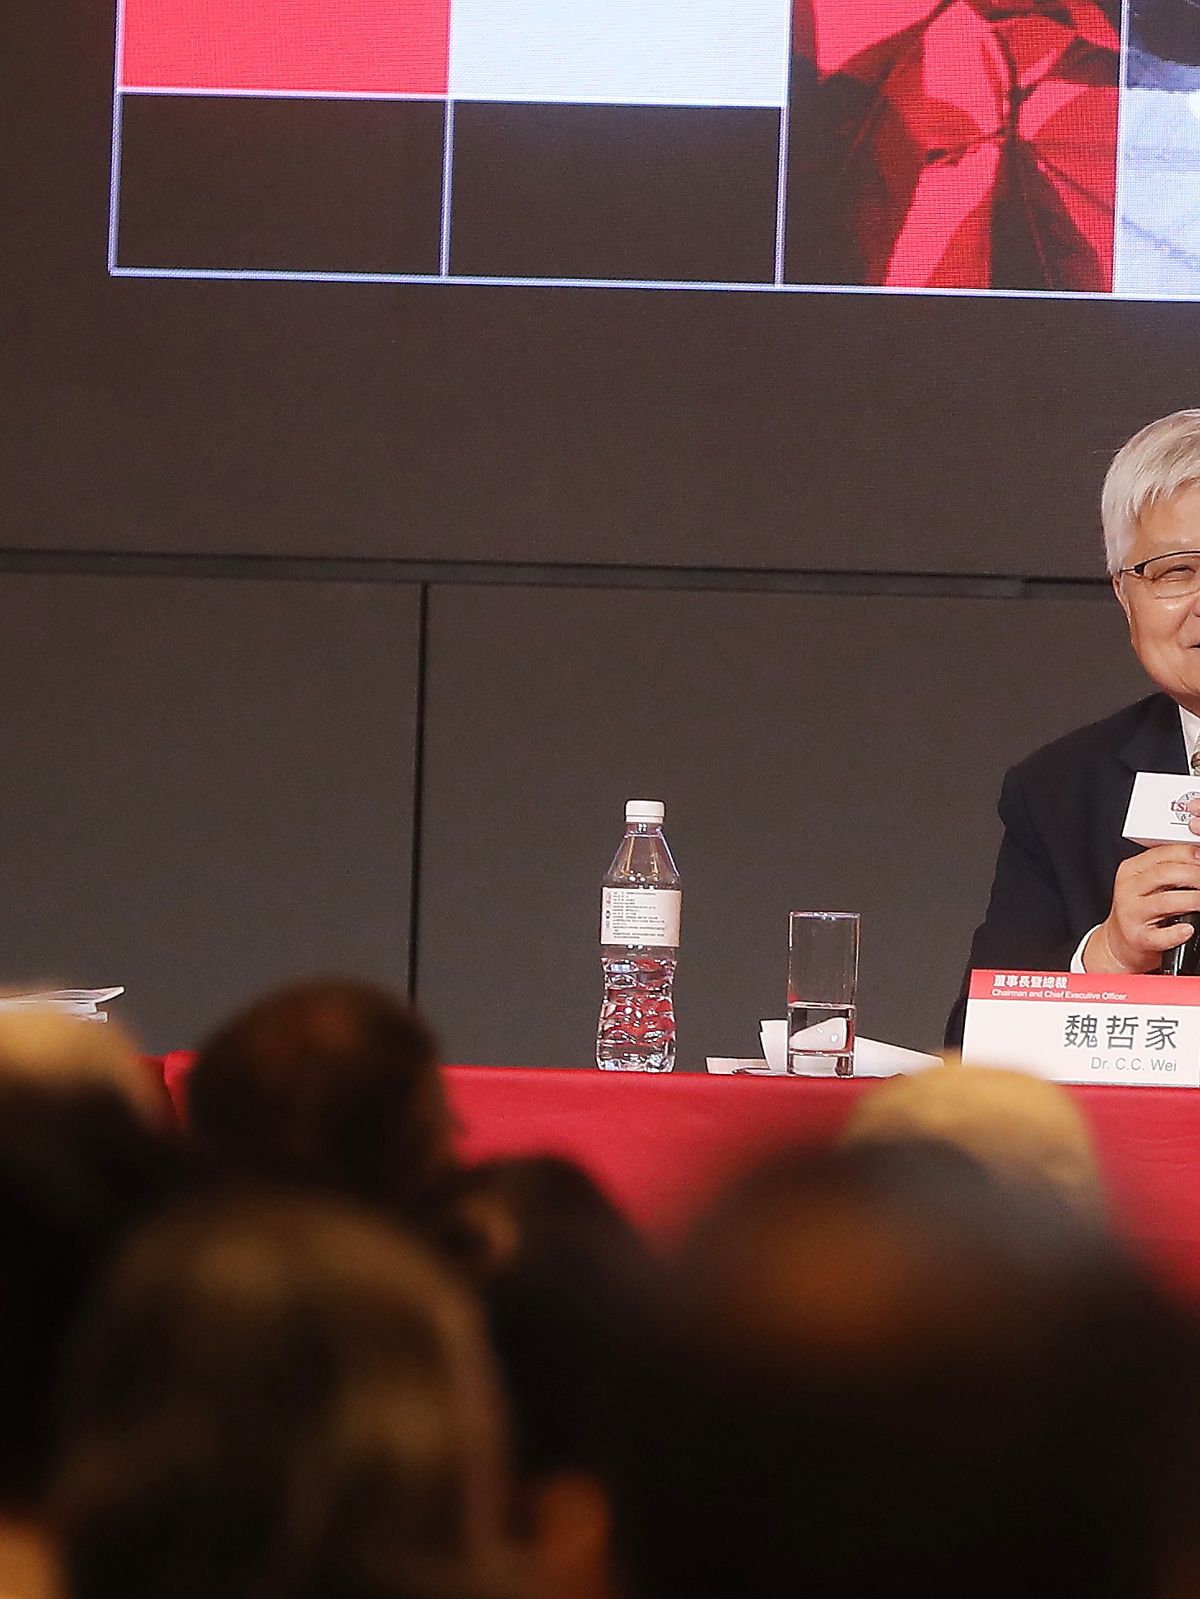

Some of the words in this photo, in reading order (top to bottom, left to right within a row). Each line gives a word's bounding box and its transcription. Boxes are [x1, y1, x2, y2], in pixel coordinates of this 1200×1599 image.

[993, 974, 1068, 989] 董事長暨總裁
[992, 989, 1028, 997] Chairman
[1044, 990, 1064, 998] Chief
[1065, 991, 1100, 999] Executive
[1101, 992, 1128, 1000] Officer
[1064, 1014, 1179, 1050] 魏哲家
[1091, 1057, 1109, 1070] Dr.
[1115, 1058, 1145, 1071] C.C.
[1150, 1058, 1177, 1072] Wei
